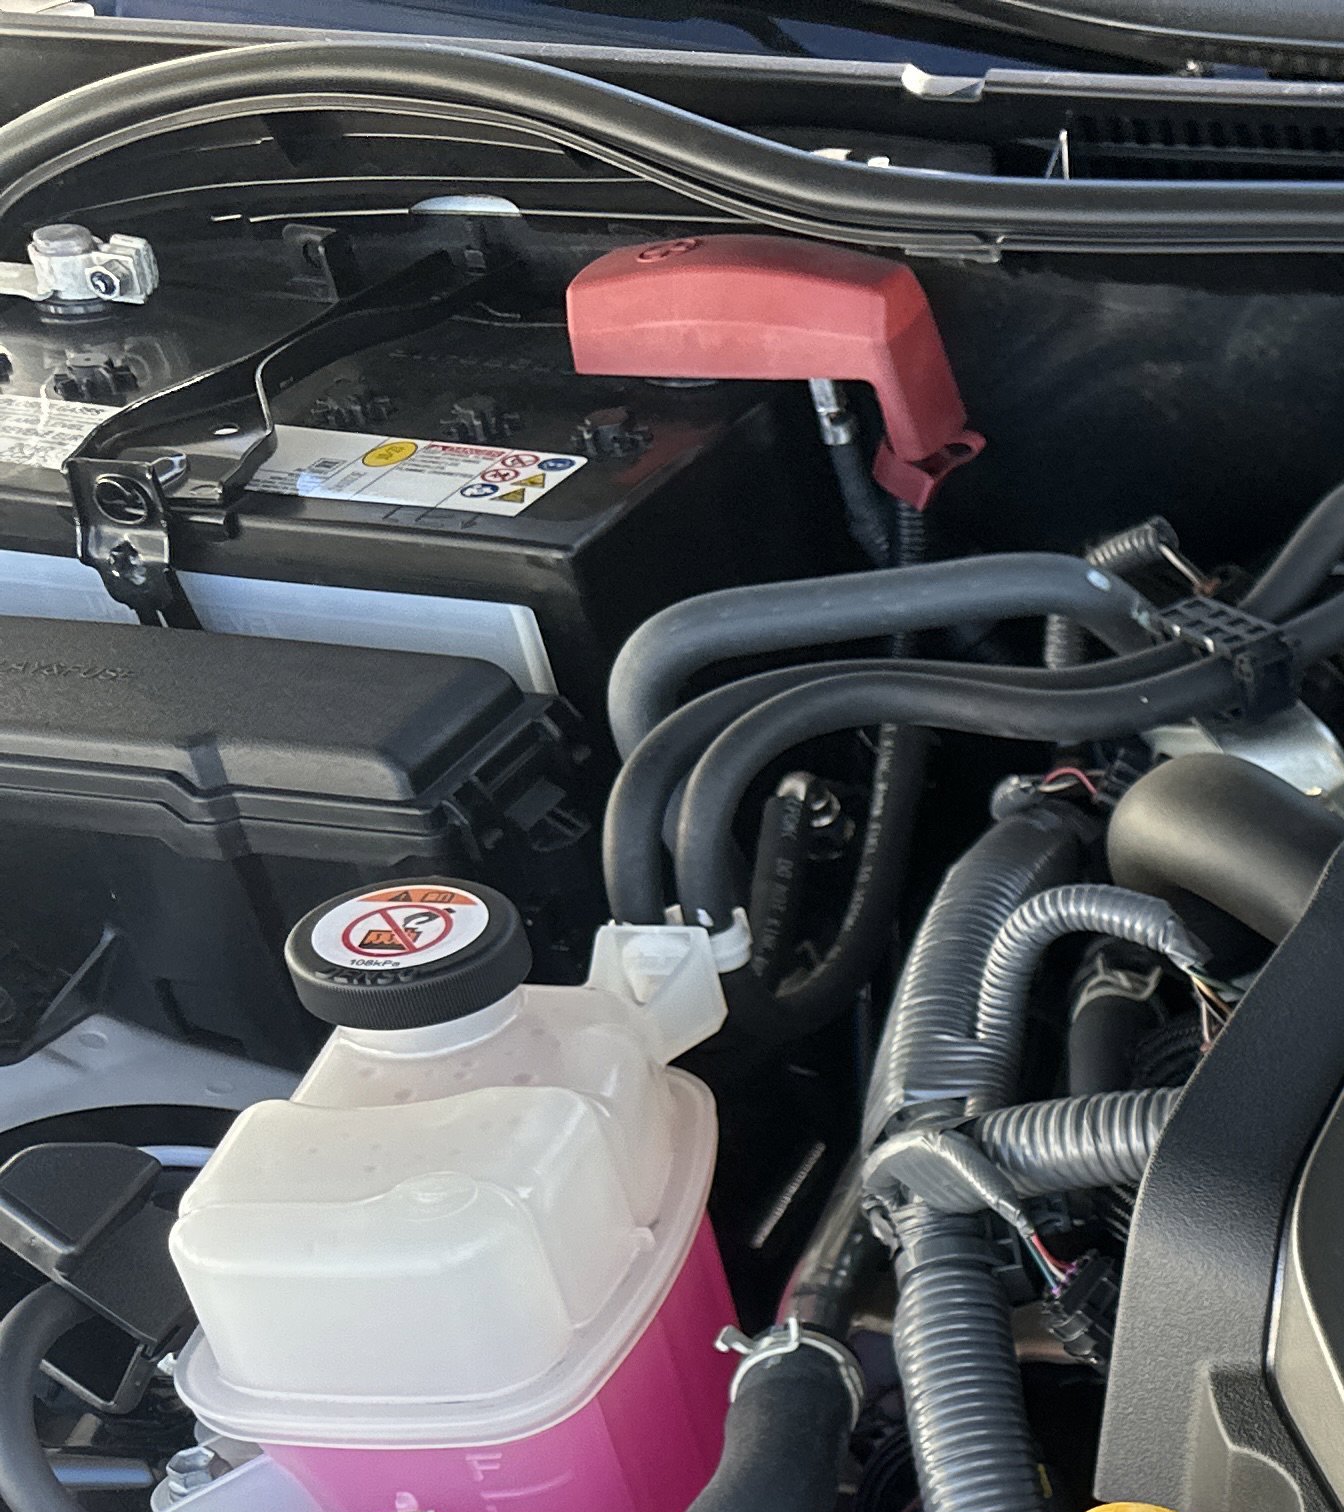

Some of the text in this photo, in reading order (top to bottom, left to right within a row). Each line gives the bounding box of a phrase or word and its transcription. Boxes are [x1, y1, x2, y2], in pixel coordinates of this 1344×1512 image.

[349, 958, 402, 968] 108kPa
[313, 967, 417, 985] DENSO
[465, 1453, 502, 1481] F
